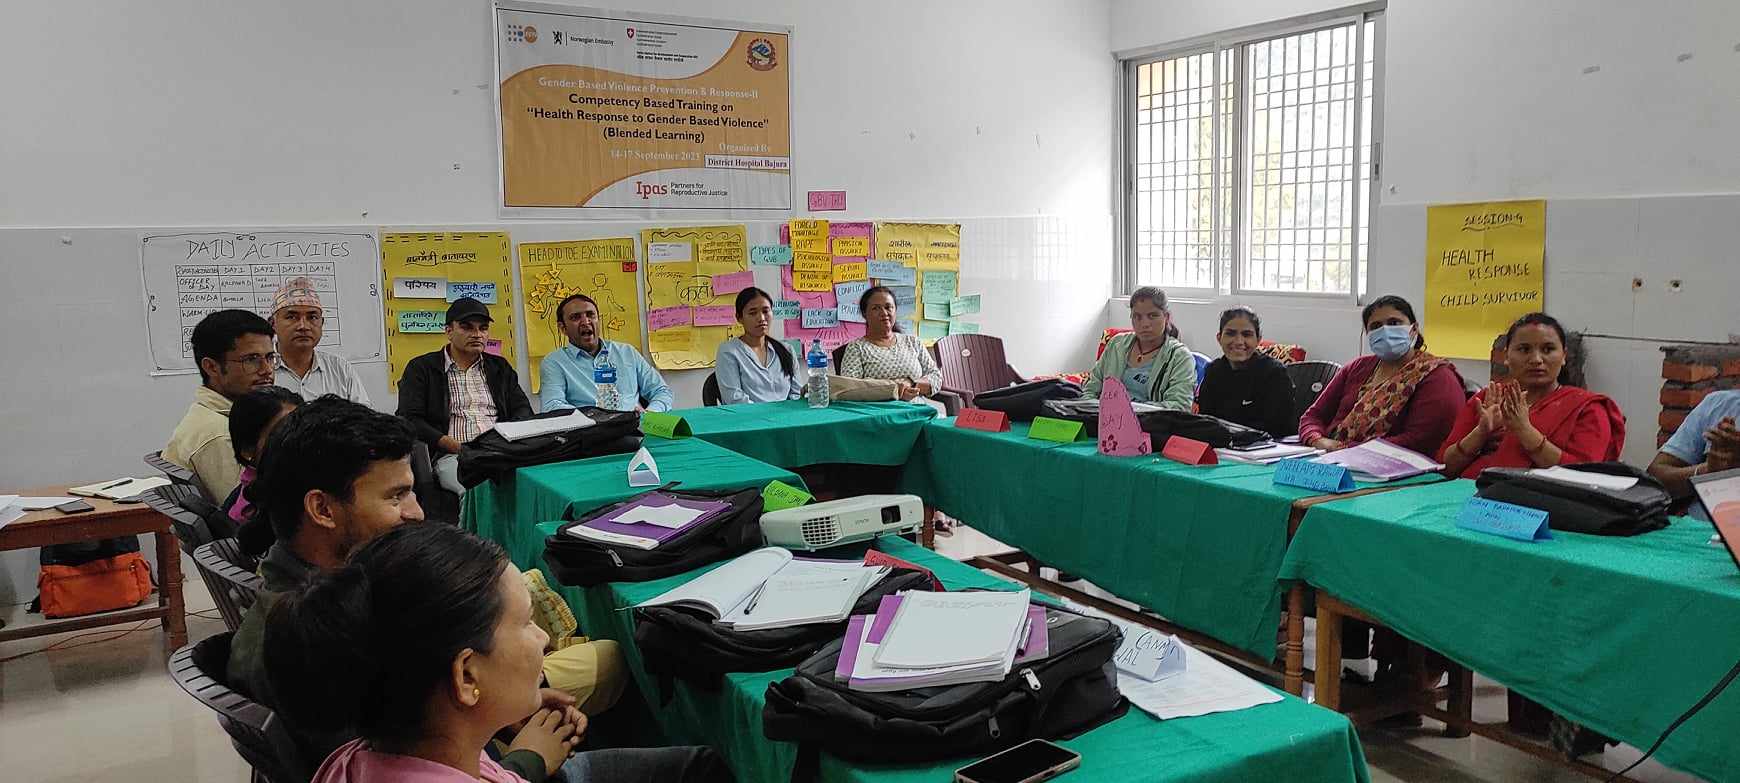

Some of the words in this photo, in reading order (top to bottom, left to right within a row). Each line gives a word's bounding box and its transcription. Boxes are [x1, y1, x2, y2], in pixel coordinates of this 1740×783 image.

[570, 35, 595, 44] Norwegian
[595, 37, 615, 46] Embassy
[539, 77, 577, 88] Gender
[578, 79, 606, 90] Based
[607, 81, 649, 92] Violence
[650, 83, 698, 96] Prevention
[568, 93, 640, 109] Competency
[643, 97, 675, 108] Based
[676, 99, 718, 113] Training
[720, 104, 734, 112] on
[576, 109, 629, 123] Response
[632, 113, 643, 123] to
[646, 113, 686, 124] Gender
[689, 115, 719, 126] Based
[603, 126, 652, 140] (Blended
[655, 129, 705, 144] Learning)
[634, 150, 678, 161] September
[680, 152, 700, 161] 2023
[708, 158, 734, 167] District
[735, 159, 763, 169] Hospital
[764, 160, 787, 169] Bajura
[636, 181, 668, 199] Ipas
[670, 189, 708, 197] Reproductive
[185, 238, 236, 260] DAILY
[528, 247, 554, 262] HEAD
[565, 246, 577, 260] TOE
[1441, 248, 1495, 267] HEALTH
[1468, 262, 1530, 281] RESPONSE
[180, 295, 218, 304] AGENDA
[1440, 294, 1479, 308] CHILD
[1482, 290, 1538, 306] SURVIVOR
